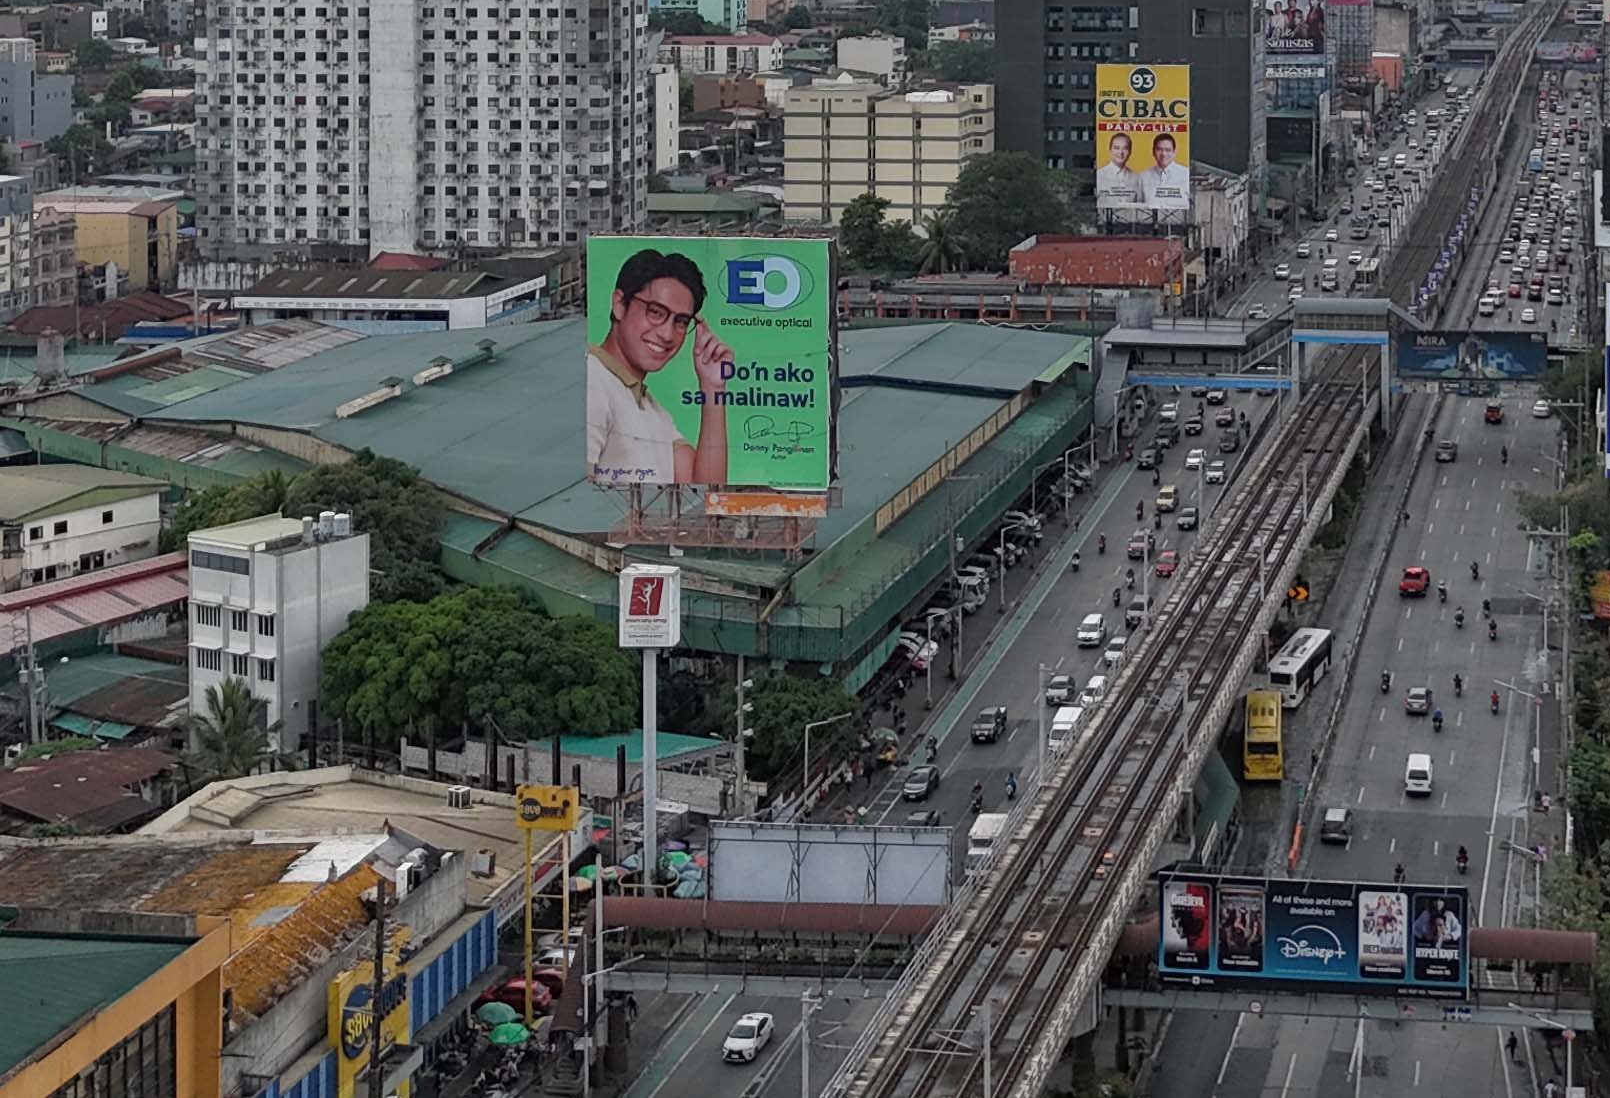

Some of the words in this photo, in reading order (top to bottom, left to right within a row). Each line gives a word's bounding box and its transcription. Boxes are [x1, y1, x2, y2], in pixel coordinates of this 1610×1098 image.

[1132, 74, 1154, 88] 93
[1099, 99, 1188, 118] CIBAC
[1106, 123, 1178, 132] PARTY-LIST
[727, 257, 800, 308] EO
[720, 316, 772, 327] executive
[775, 318, 812, 329] optical
[774, 363, 815, 383] ako
[681, 390, 706, 406] sa
[714, 387, 815, 408] malinaw!
[1272, 895, 1283, 903] All
[1284, 895, 1292, 903] of
[1293, 896, 1314, 905] these
[1316, 897, 1331, 905] and
[1289, 907, 1323, 915] available
[1277, 937, 1346, 965] Disney+
